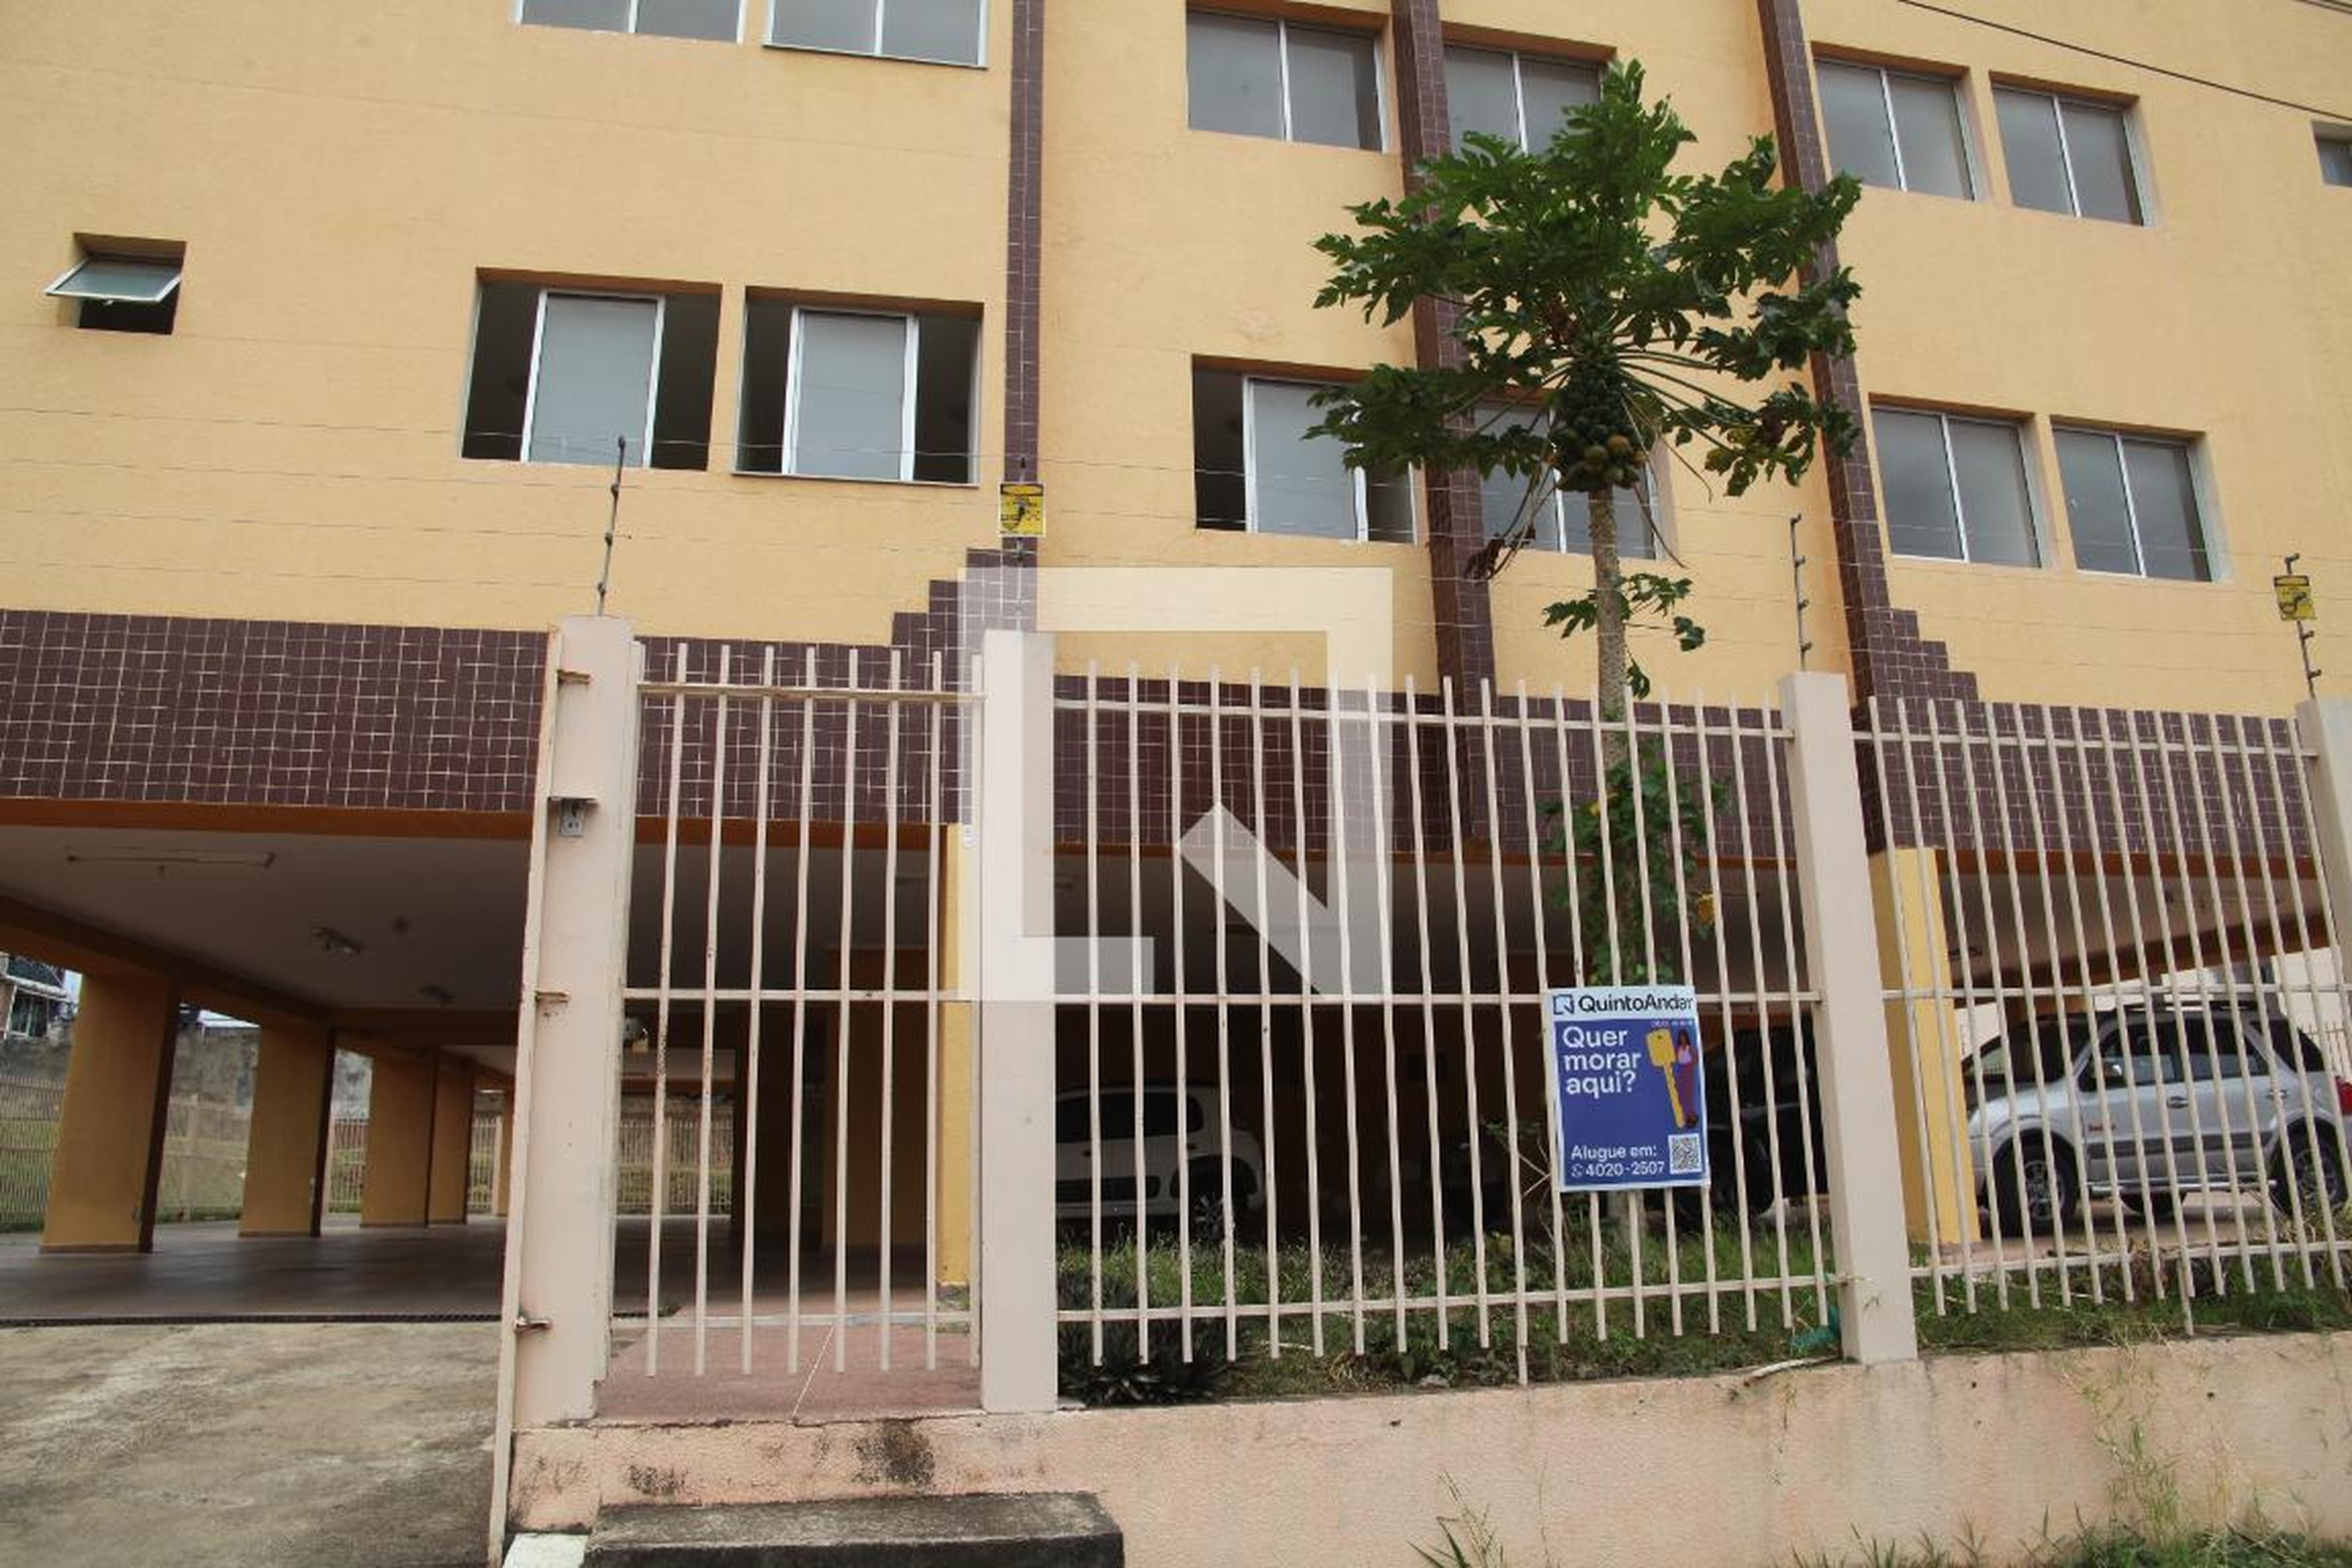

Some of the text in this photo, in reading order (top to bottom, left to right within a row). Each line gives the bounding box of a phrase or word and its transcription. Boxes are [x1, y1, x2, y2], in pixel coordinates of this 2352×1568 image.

[1578, 994, 1693, 1012] QuintoAndar
[1562, 1026, 1627, 1048] Quer
[1563, 1052, 1641, 1071] morar
[1566, 1071, 1636, 1099] aqui?
[1571, 1145, 1657, 1163] Alugue em:
